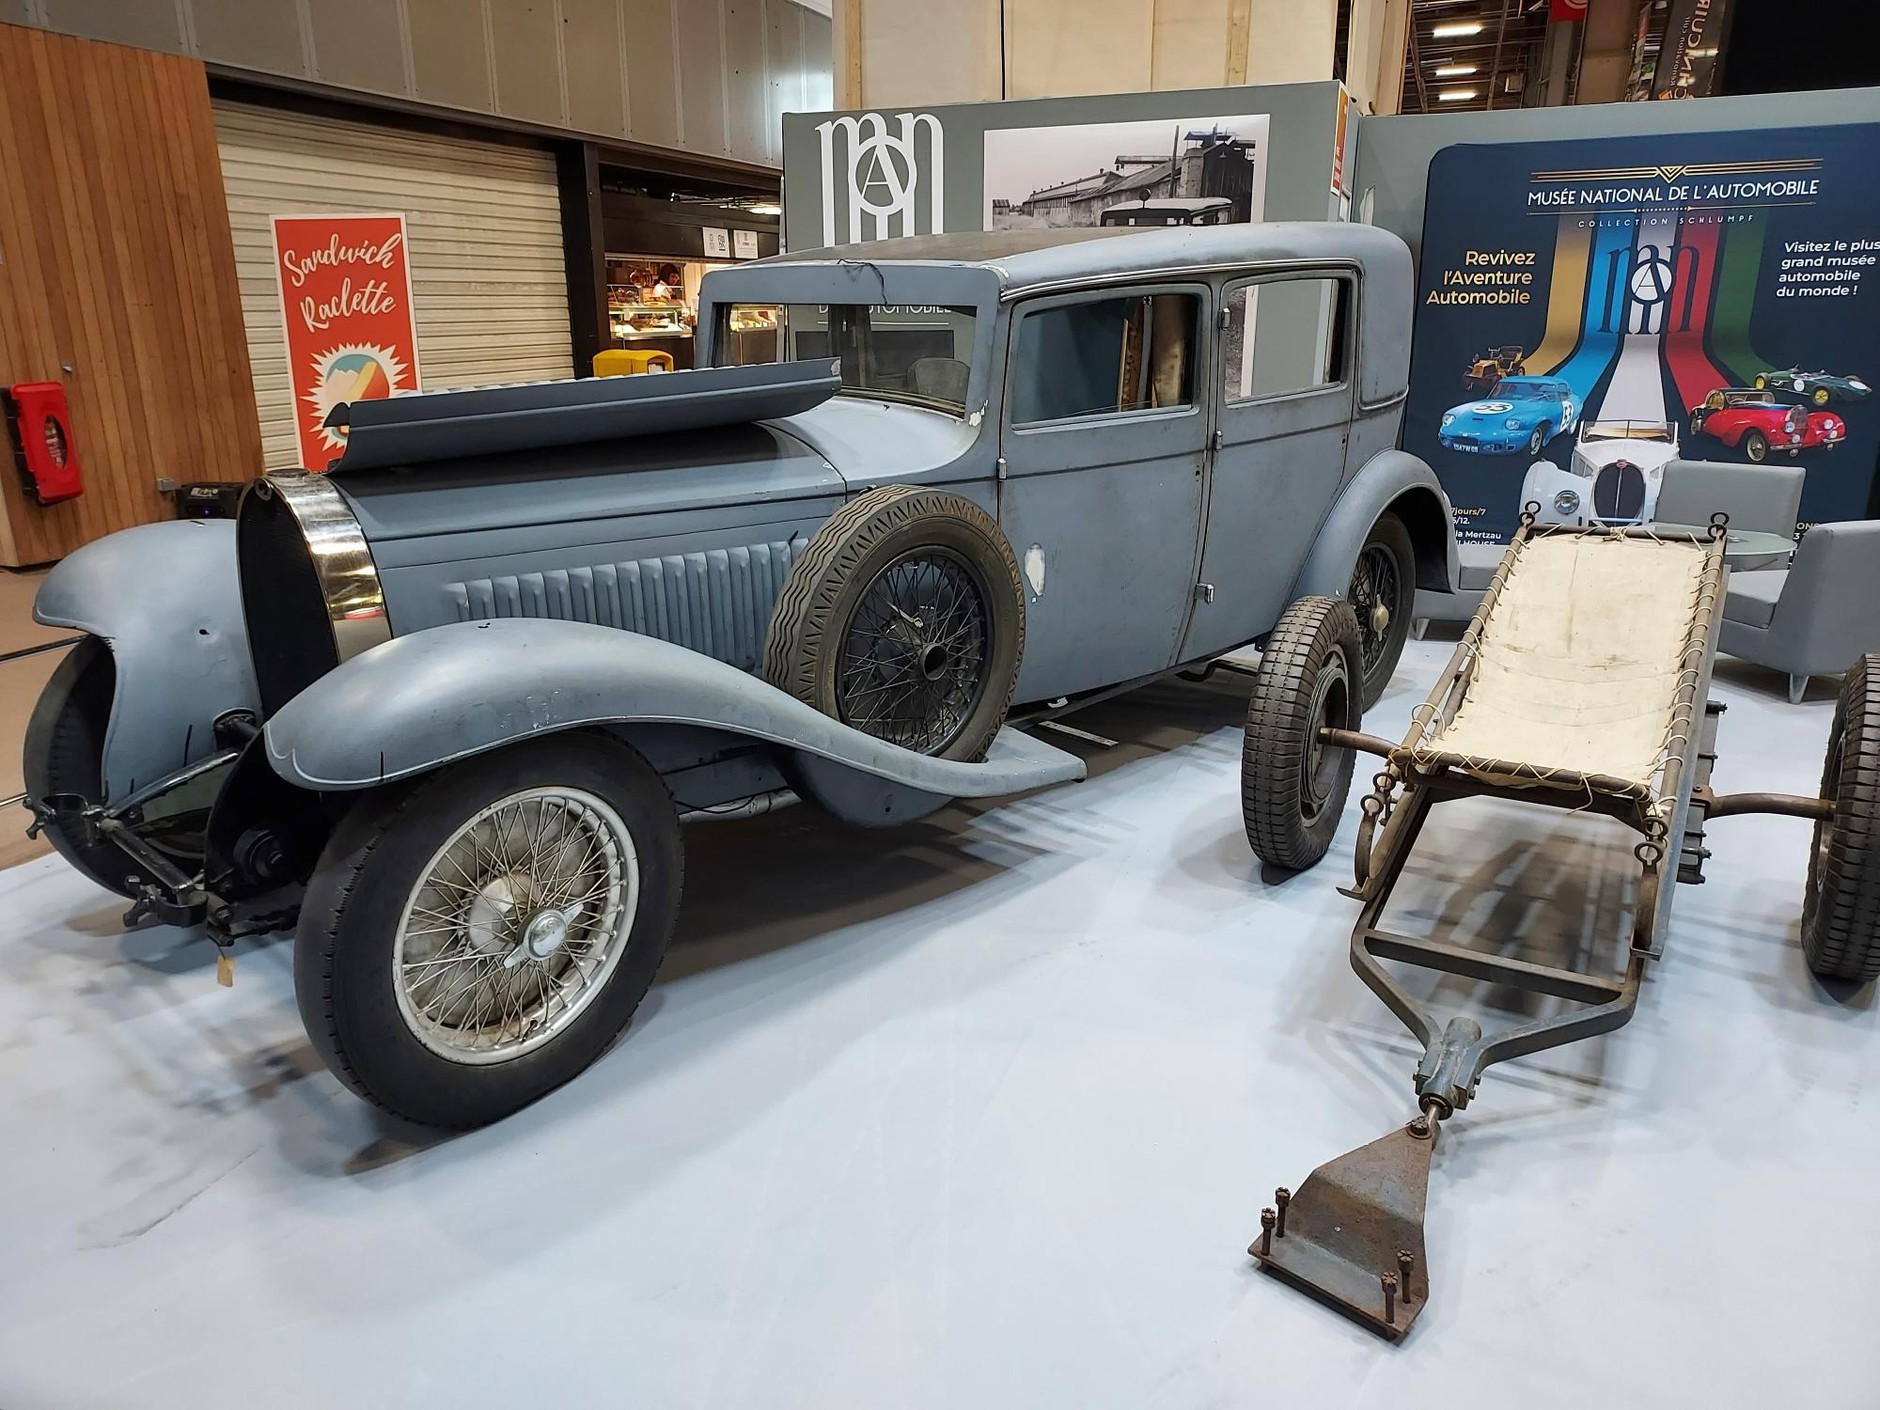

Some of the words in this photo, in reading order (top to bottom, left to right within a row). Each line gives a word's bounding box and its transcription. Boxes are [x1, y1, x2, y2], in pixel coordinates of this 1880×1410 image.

[1528, 187, 1576, 206] MUSÉE
[1580, 186, 1663, 204] NATIONAL
[1668, 185, 1689, 201] DE
[1693, 179, 1820, 200] L'AUTOMOBILE
[1578, 217, 1669, 228] COLLECTION
[1679, 214, 1754, 225] SCHLUMPF
[1784, 241, 1831, 253] Visitez
[1834, 240, 1847, 252] le
[1850, 239, 1880, 253] plus
[284, 233, 402, 287] Sandwich
[1465, 249, 1536, 266] Revivez
[1781, 255, 1824, 270] grand
[1827, 254, 1876, 266] musée
[1443, 270, 1533, 286] l'Aventure
[1778, 269, 1861, 283] automobile
[1426, 288, 1531, 305] Automobile
[1776, 286, 1795, 297] du
[1798, 284, 1850, 297] monde
[1852, 285, 1858, 295] !
[300, 277, 396, 333] Raclette
[1465, 531, 1502, 540] Mertzau
